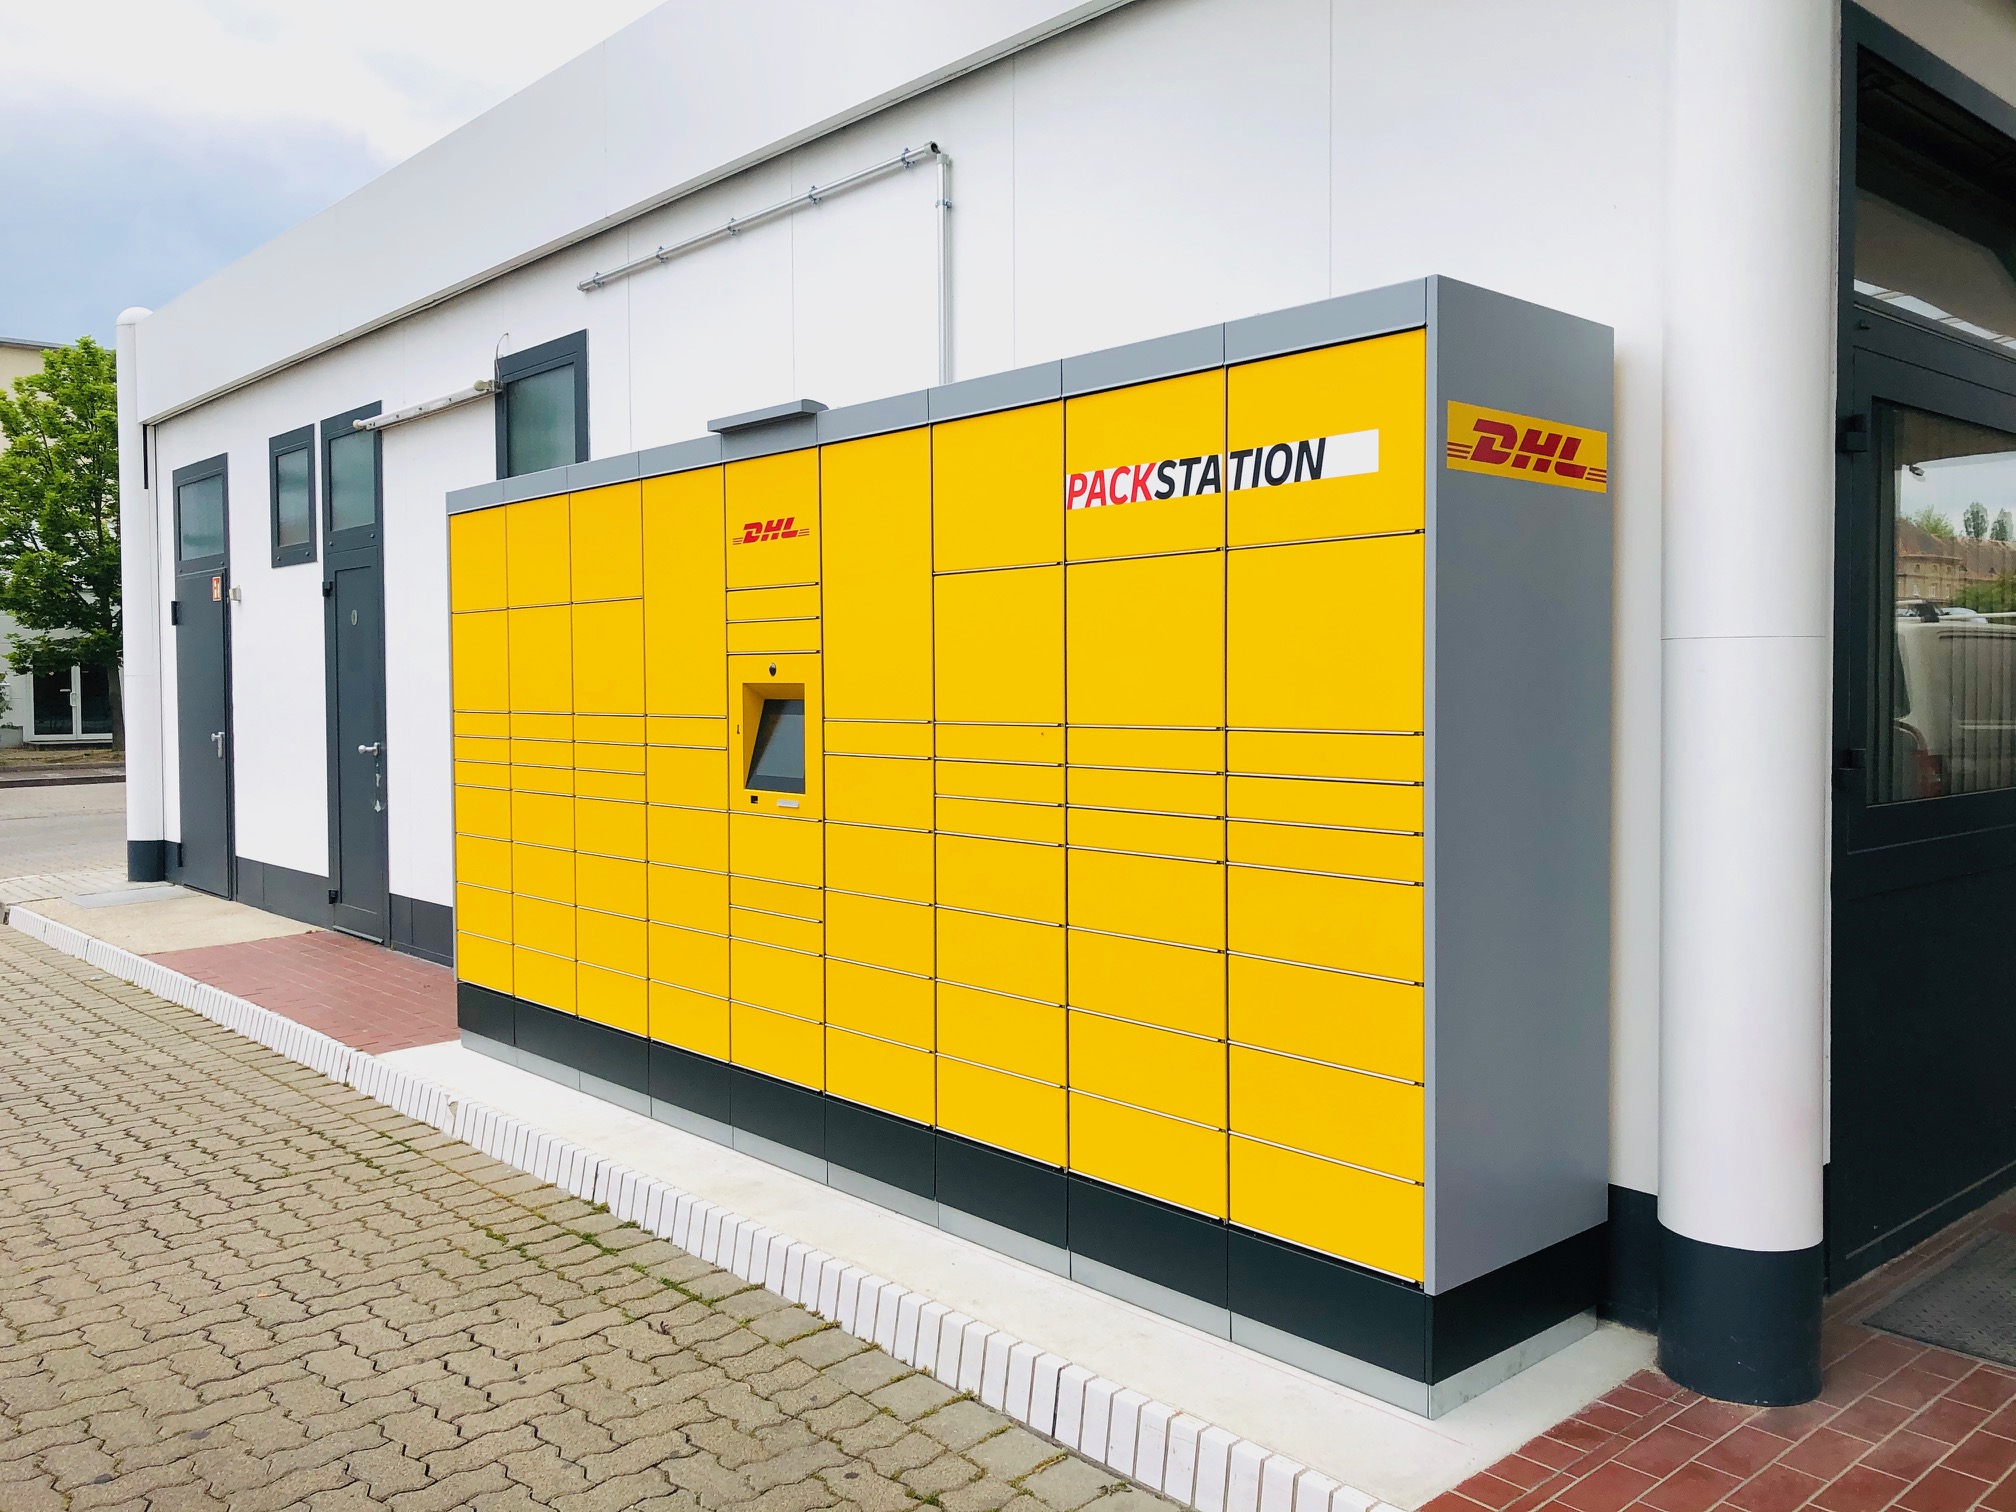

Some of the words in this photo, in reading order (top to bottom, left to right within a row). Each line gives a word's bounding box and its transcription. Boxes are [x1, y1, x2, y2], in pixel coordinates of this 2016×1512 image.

[1067, 438, 1325, 509] PACKSTATION
[1471, 419, 1586, 478] DHL
[744, 517, 798, 543] DHL
